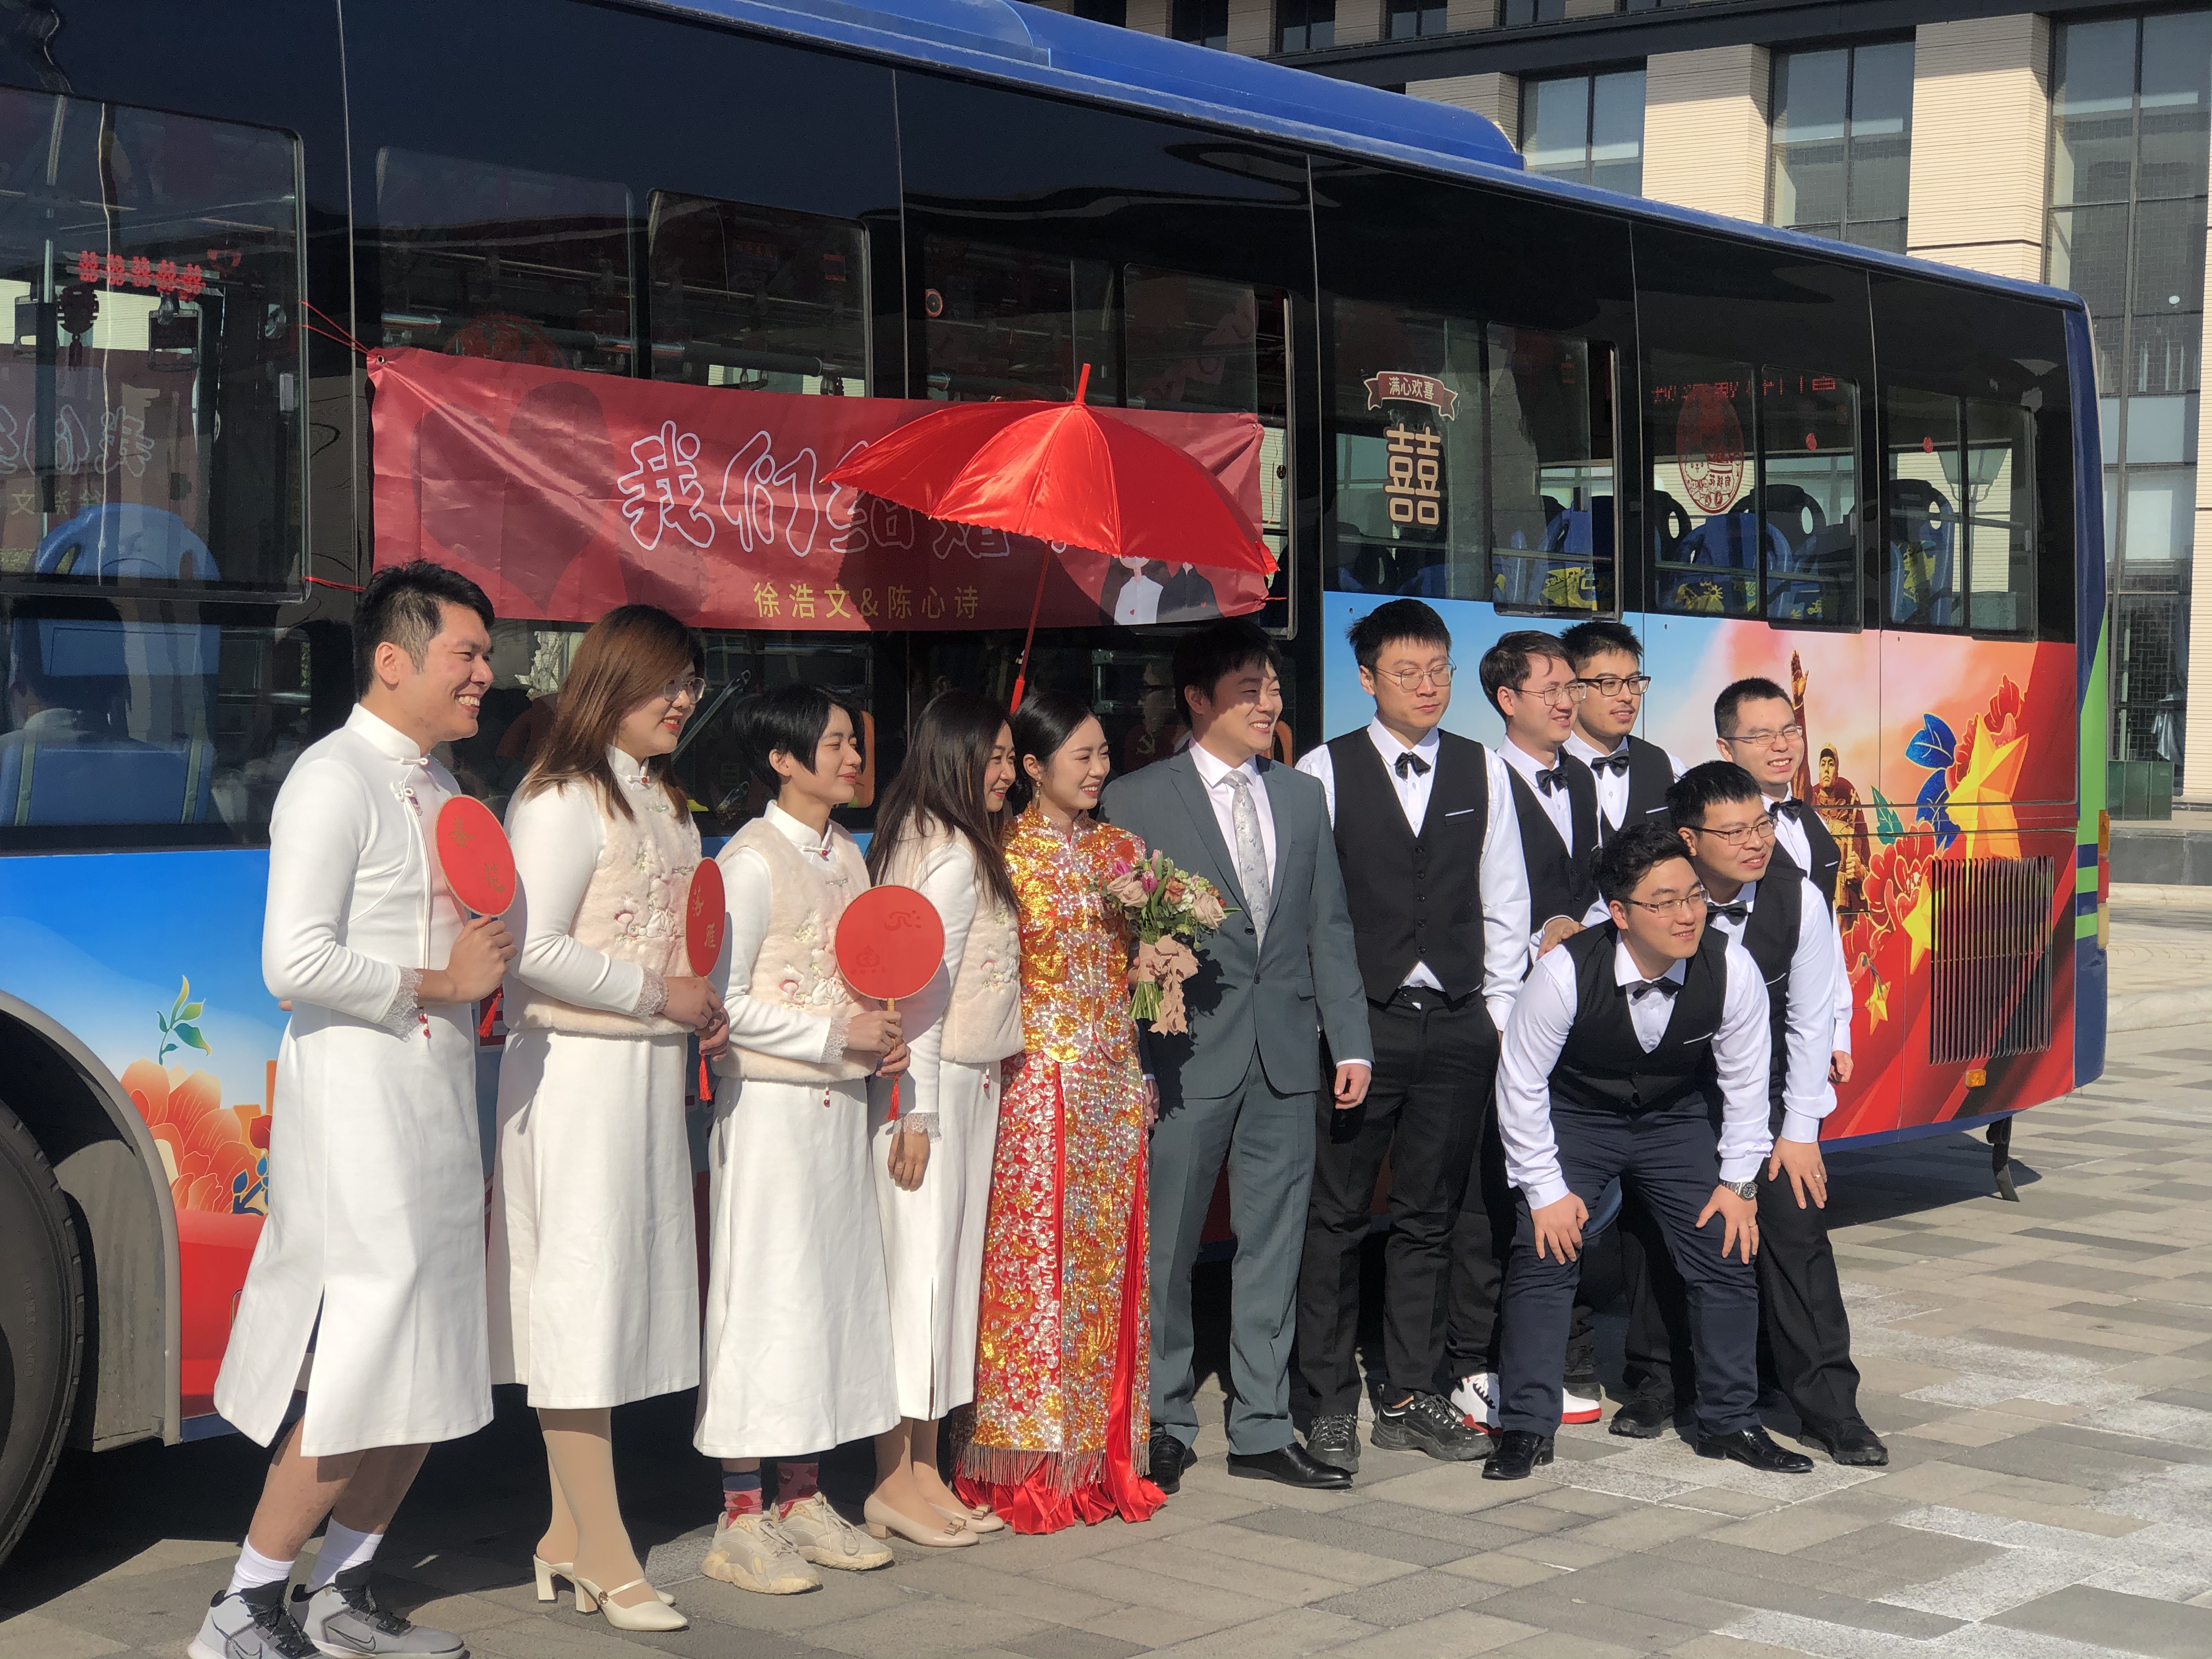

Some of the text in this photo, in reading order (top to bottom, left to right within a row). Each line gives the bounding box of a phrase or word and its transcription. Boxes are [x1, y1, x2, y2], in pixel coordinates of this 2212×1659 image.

[1388, 376, 1435, 401] 满心欢喜
[753, 583, 979, 620] 徐浩文&陈心诗
